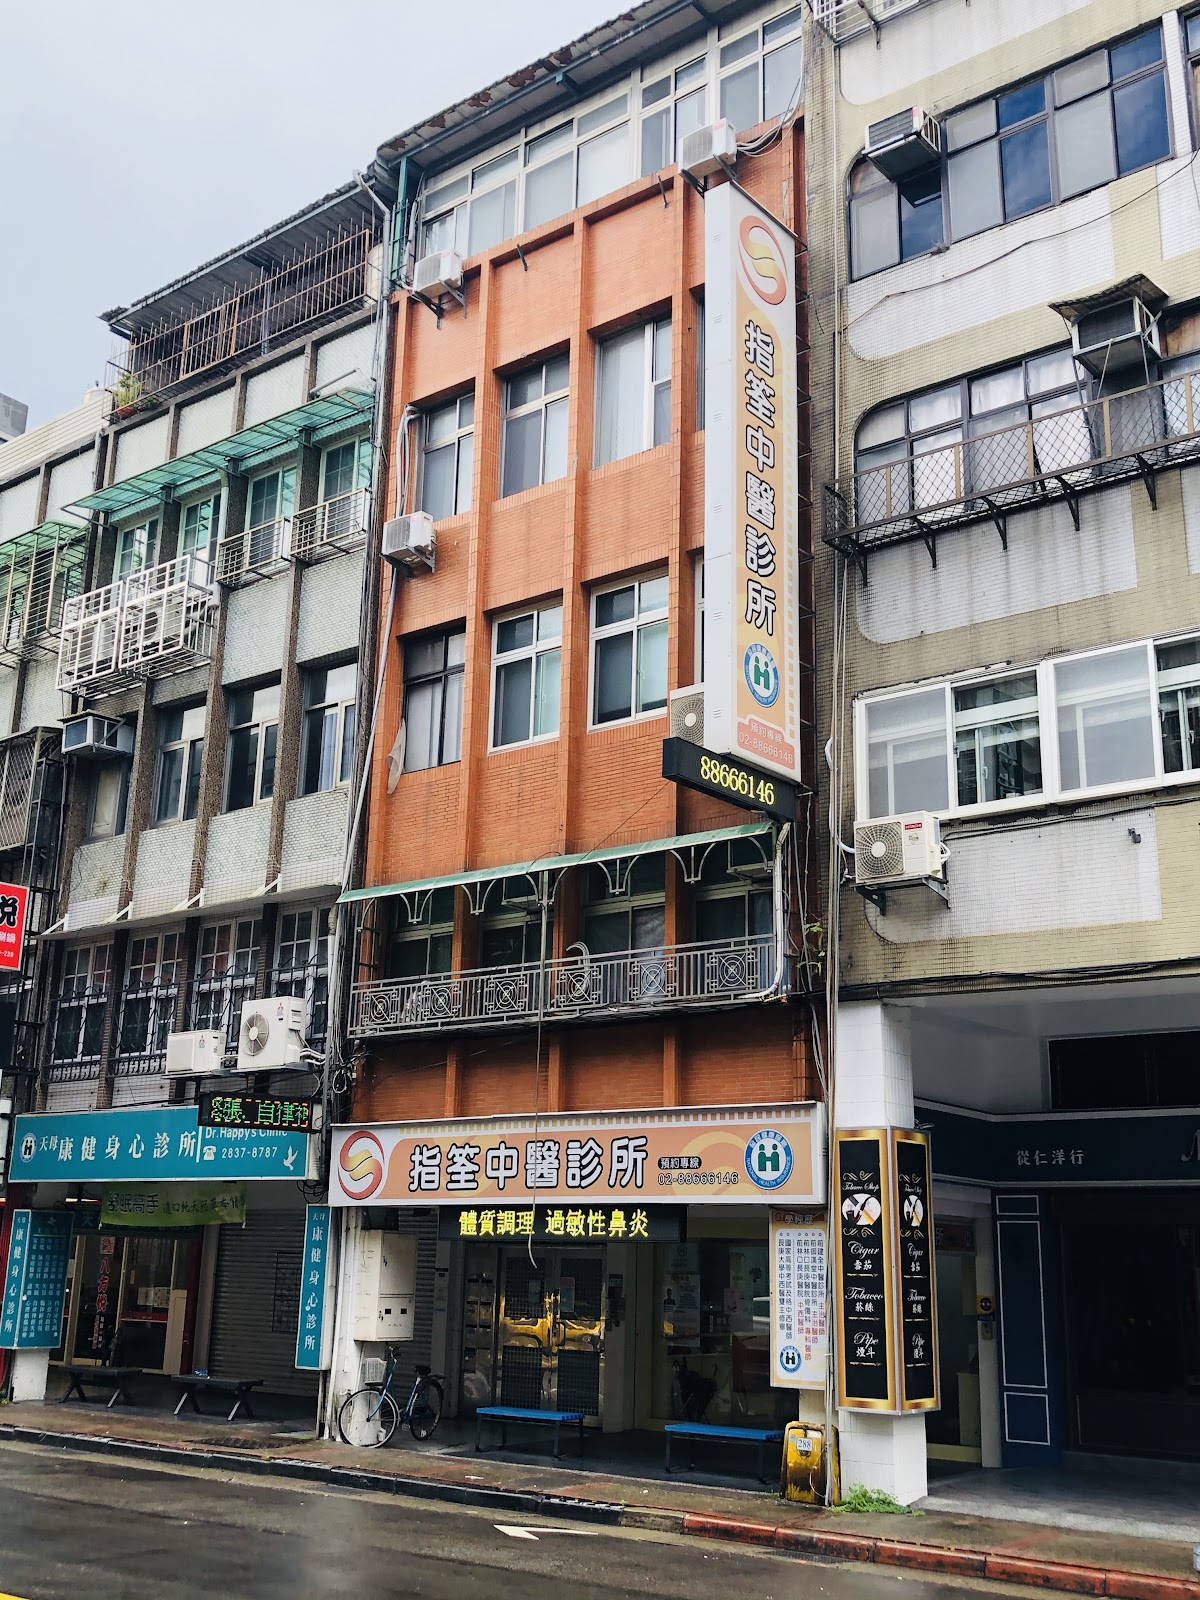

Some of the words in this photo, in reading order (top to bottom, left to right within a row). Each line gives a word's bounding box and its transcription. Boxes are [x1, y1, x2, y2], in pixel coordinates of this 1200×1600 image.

[744, 319, 777, 637] 指筌中醫診所
[739, 732, 794, 764] 02-88666146
[700, 755, 775, 805] 88666146
[57, 1130, 197, 1162] 康健身心診所
[221, 1146, 278, 1159] 2837-8787
[408, 1135, 648, 1194] 指筌中醫診所
[660, 1157, 700, 1169] 預約專線
[1016, 1149, 1085, 1166] 從仁洋行
[658, 1172, 739, 1185] 02-88666146
[458, 1210, 536, 1237] 體質調理
[545, 1208, 649, 1237] 過敏性鼻炎
[847, 1241, 880, 1259] Cigar
[853, 1259, 873, 1270] 雪茄
[4, 1228, 24, 1333] 康健身心診所
[303, 1226, 323, 1351] 康健身心診所
[845, 1286, 883, 1300] Tobacco
[853, 1331, 879, 1349] Pipe
[798, 1439, 812, 1448] 288
